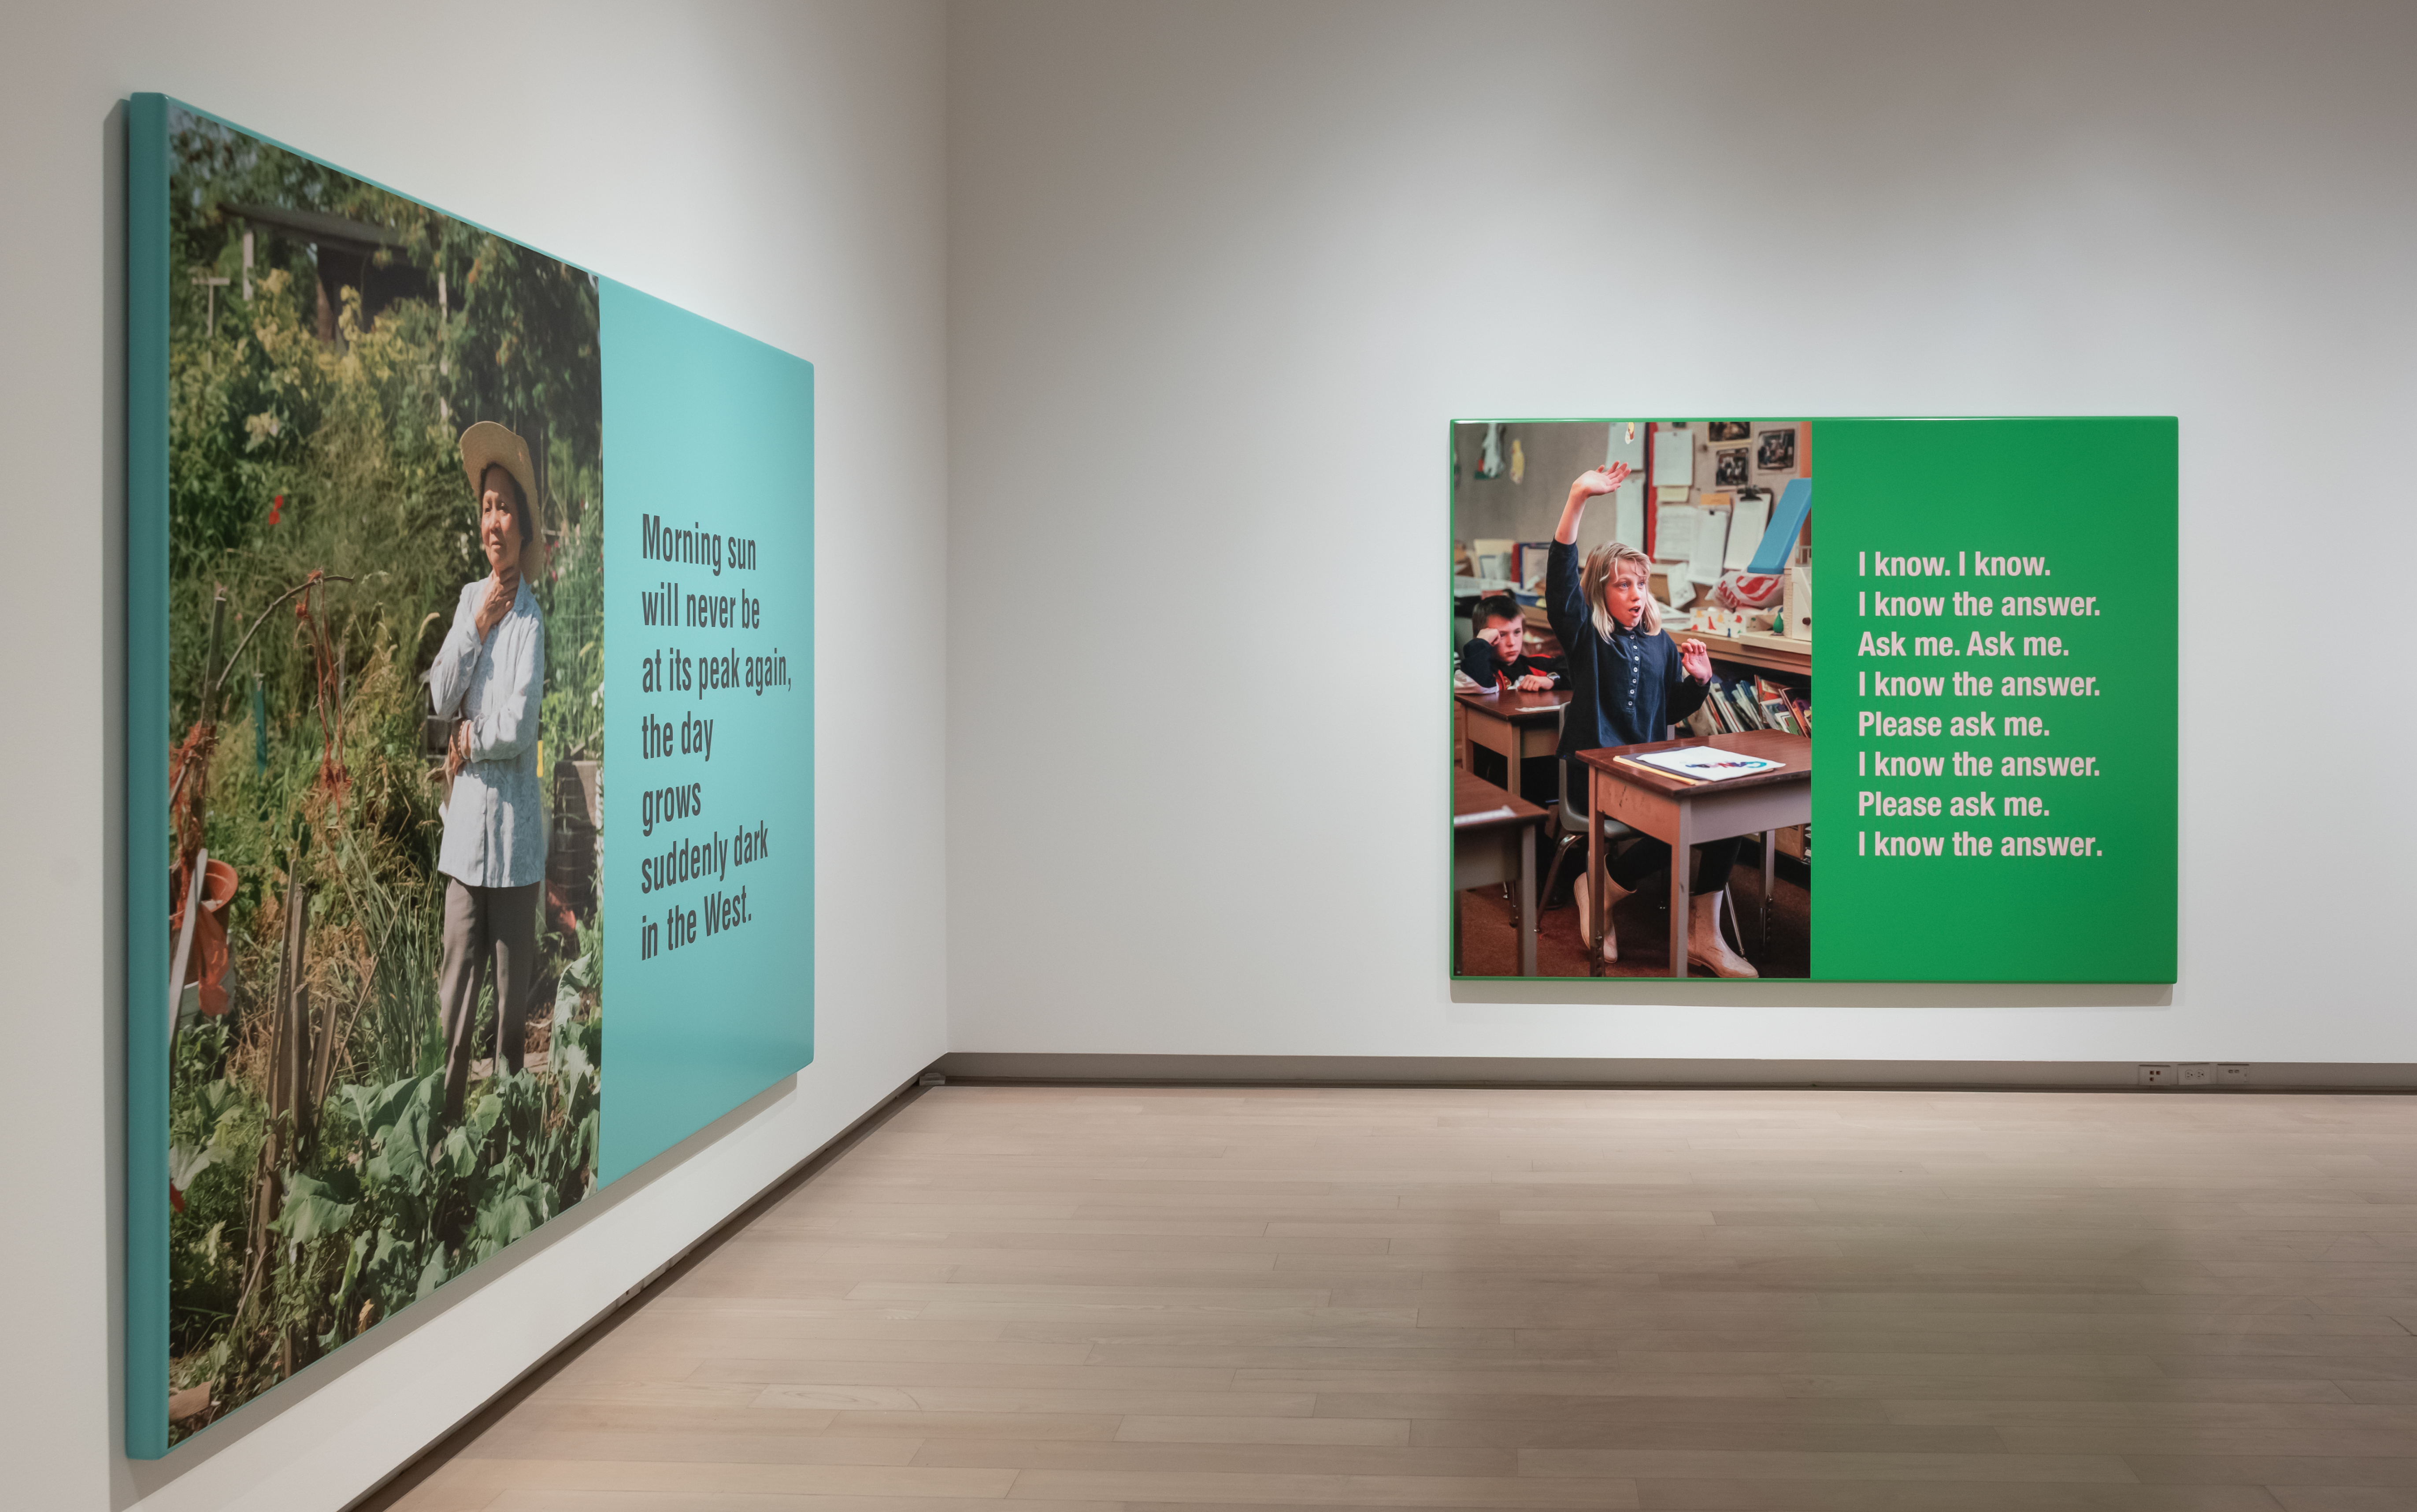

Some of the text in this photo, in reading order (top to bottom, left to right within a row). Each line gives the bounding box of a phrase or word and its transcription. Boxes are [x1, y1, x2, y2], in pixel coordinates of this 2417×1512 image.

[642, 513, 756, 577] Morning sun
[1859, 551, 2051, 577] I know. I know.
[641, 582, 760, 630] will never be
[1859, 591, 2100, 617] I know the answer.
[1857, 630, 2069, 657] Ask me. Ask me.
[642, 647, 791, 700] at its peak again,
[1859, 671, 2100, 697] I know the answer.
[641, 711, 714, 764] the day
[1858, 711, 2050, 737] Please ask me.
[1859, 751, 2100, 777] I know the answer.
[642, 782, 701, 837] grows
[1858, 791, 2050, 817] Please ask me.
[641, 819, 768, 894] suddenly dark
[1858, 830, 2102, 857] I know the answer.
[641, 885, 752, 961] in the West.
